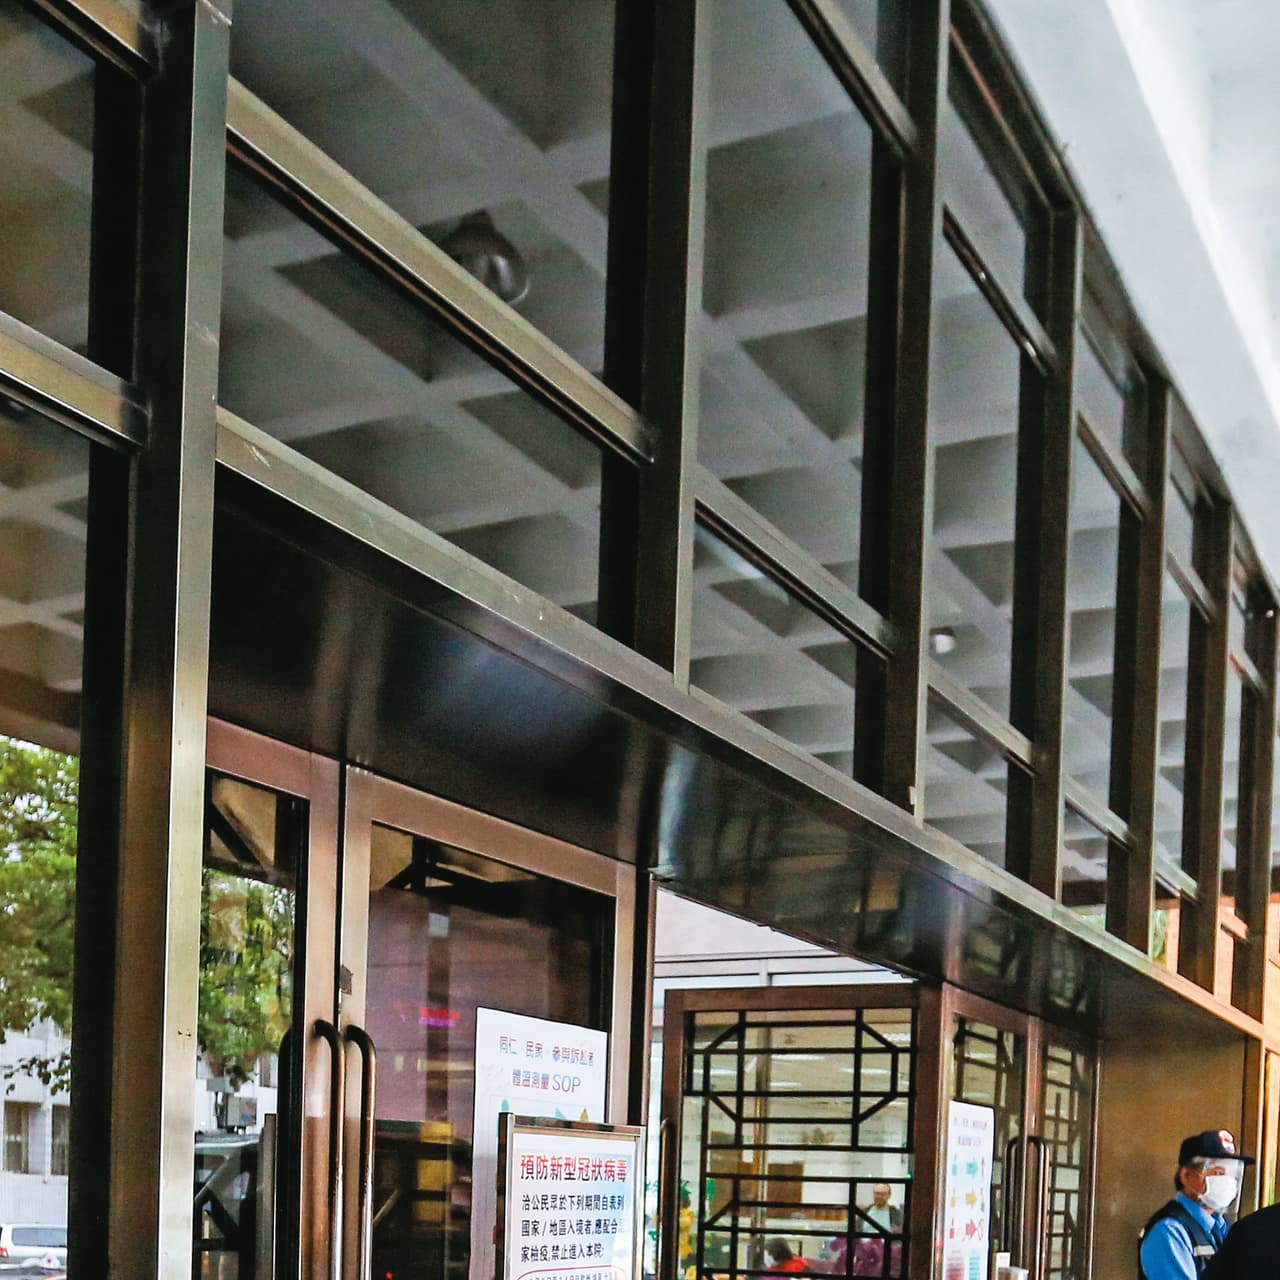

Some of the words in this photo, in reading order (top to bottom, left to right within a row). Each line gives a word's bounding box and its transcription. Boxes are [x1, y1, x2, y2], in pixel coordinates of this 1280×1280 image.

[552, 1073, 581, 1093] SOP
[520, 1154, 628, 1183] 預防新型冠狀病毒
